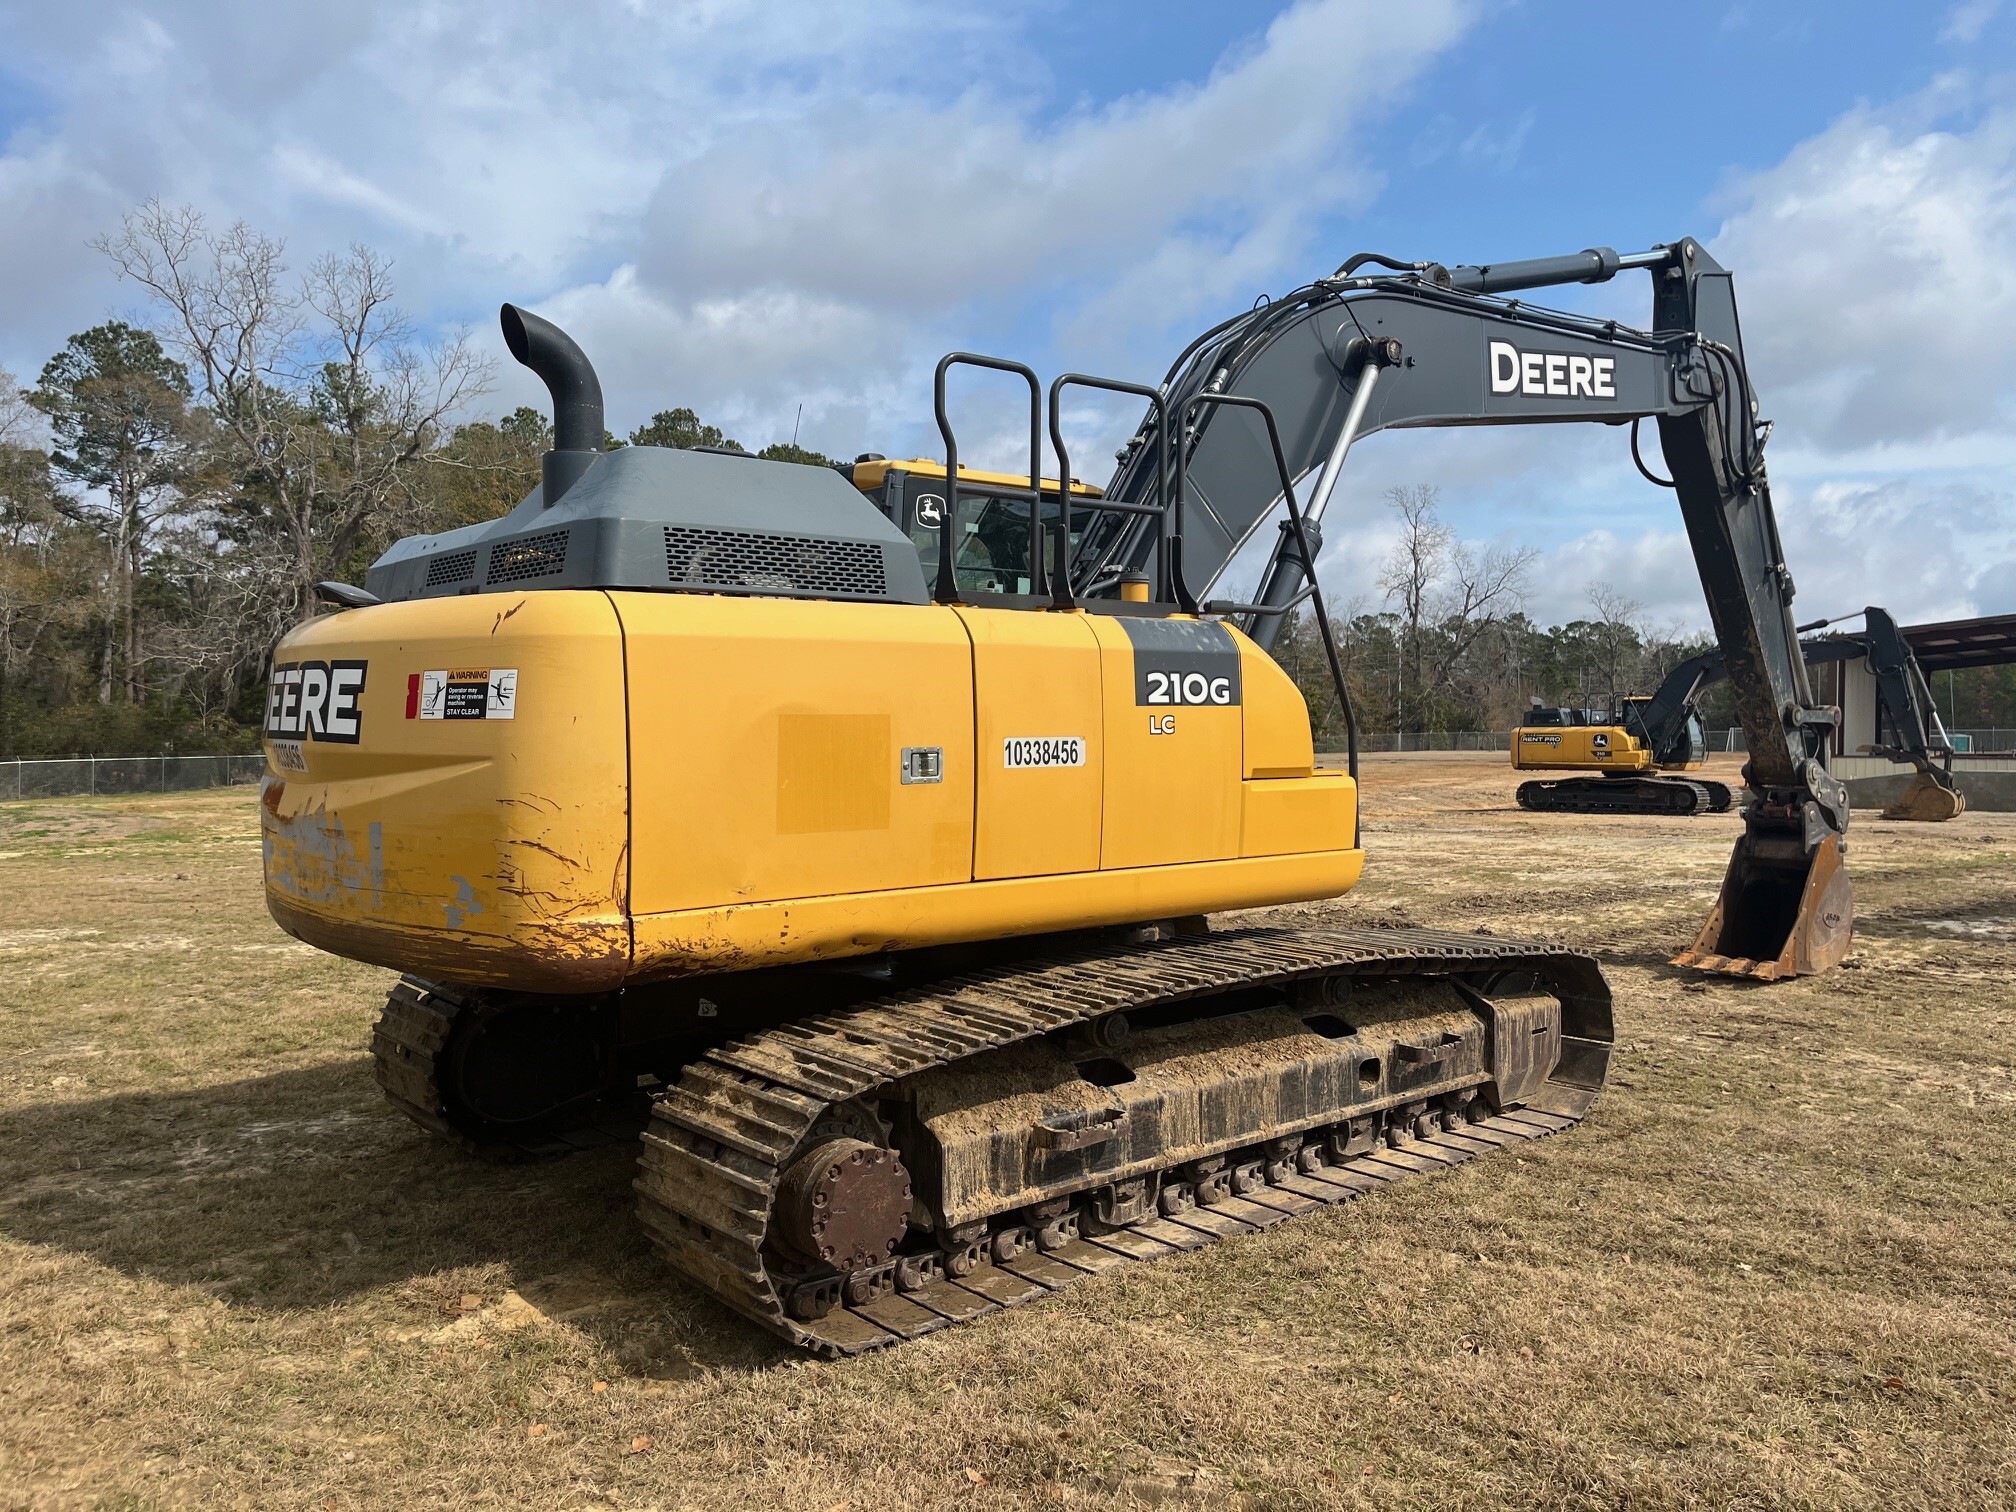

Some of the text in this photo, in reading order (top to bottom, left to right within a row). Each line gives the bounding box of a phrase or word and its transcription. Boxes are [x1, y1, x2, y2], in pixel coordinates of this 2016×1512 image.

[1489, 341, 1616, 398] DEERE
[455, 670, 488, 680] WARNING
[1146, 671, 1231, 705] 210G
[264, 661, 367, 743] EERE
[1149, 715, 1175, 735] LC
[1004, 740, 1079, 766] 10338456
